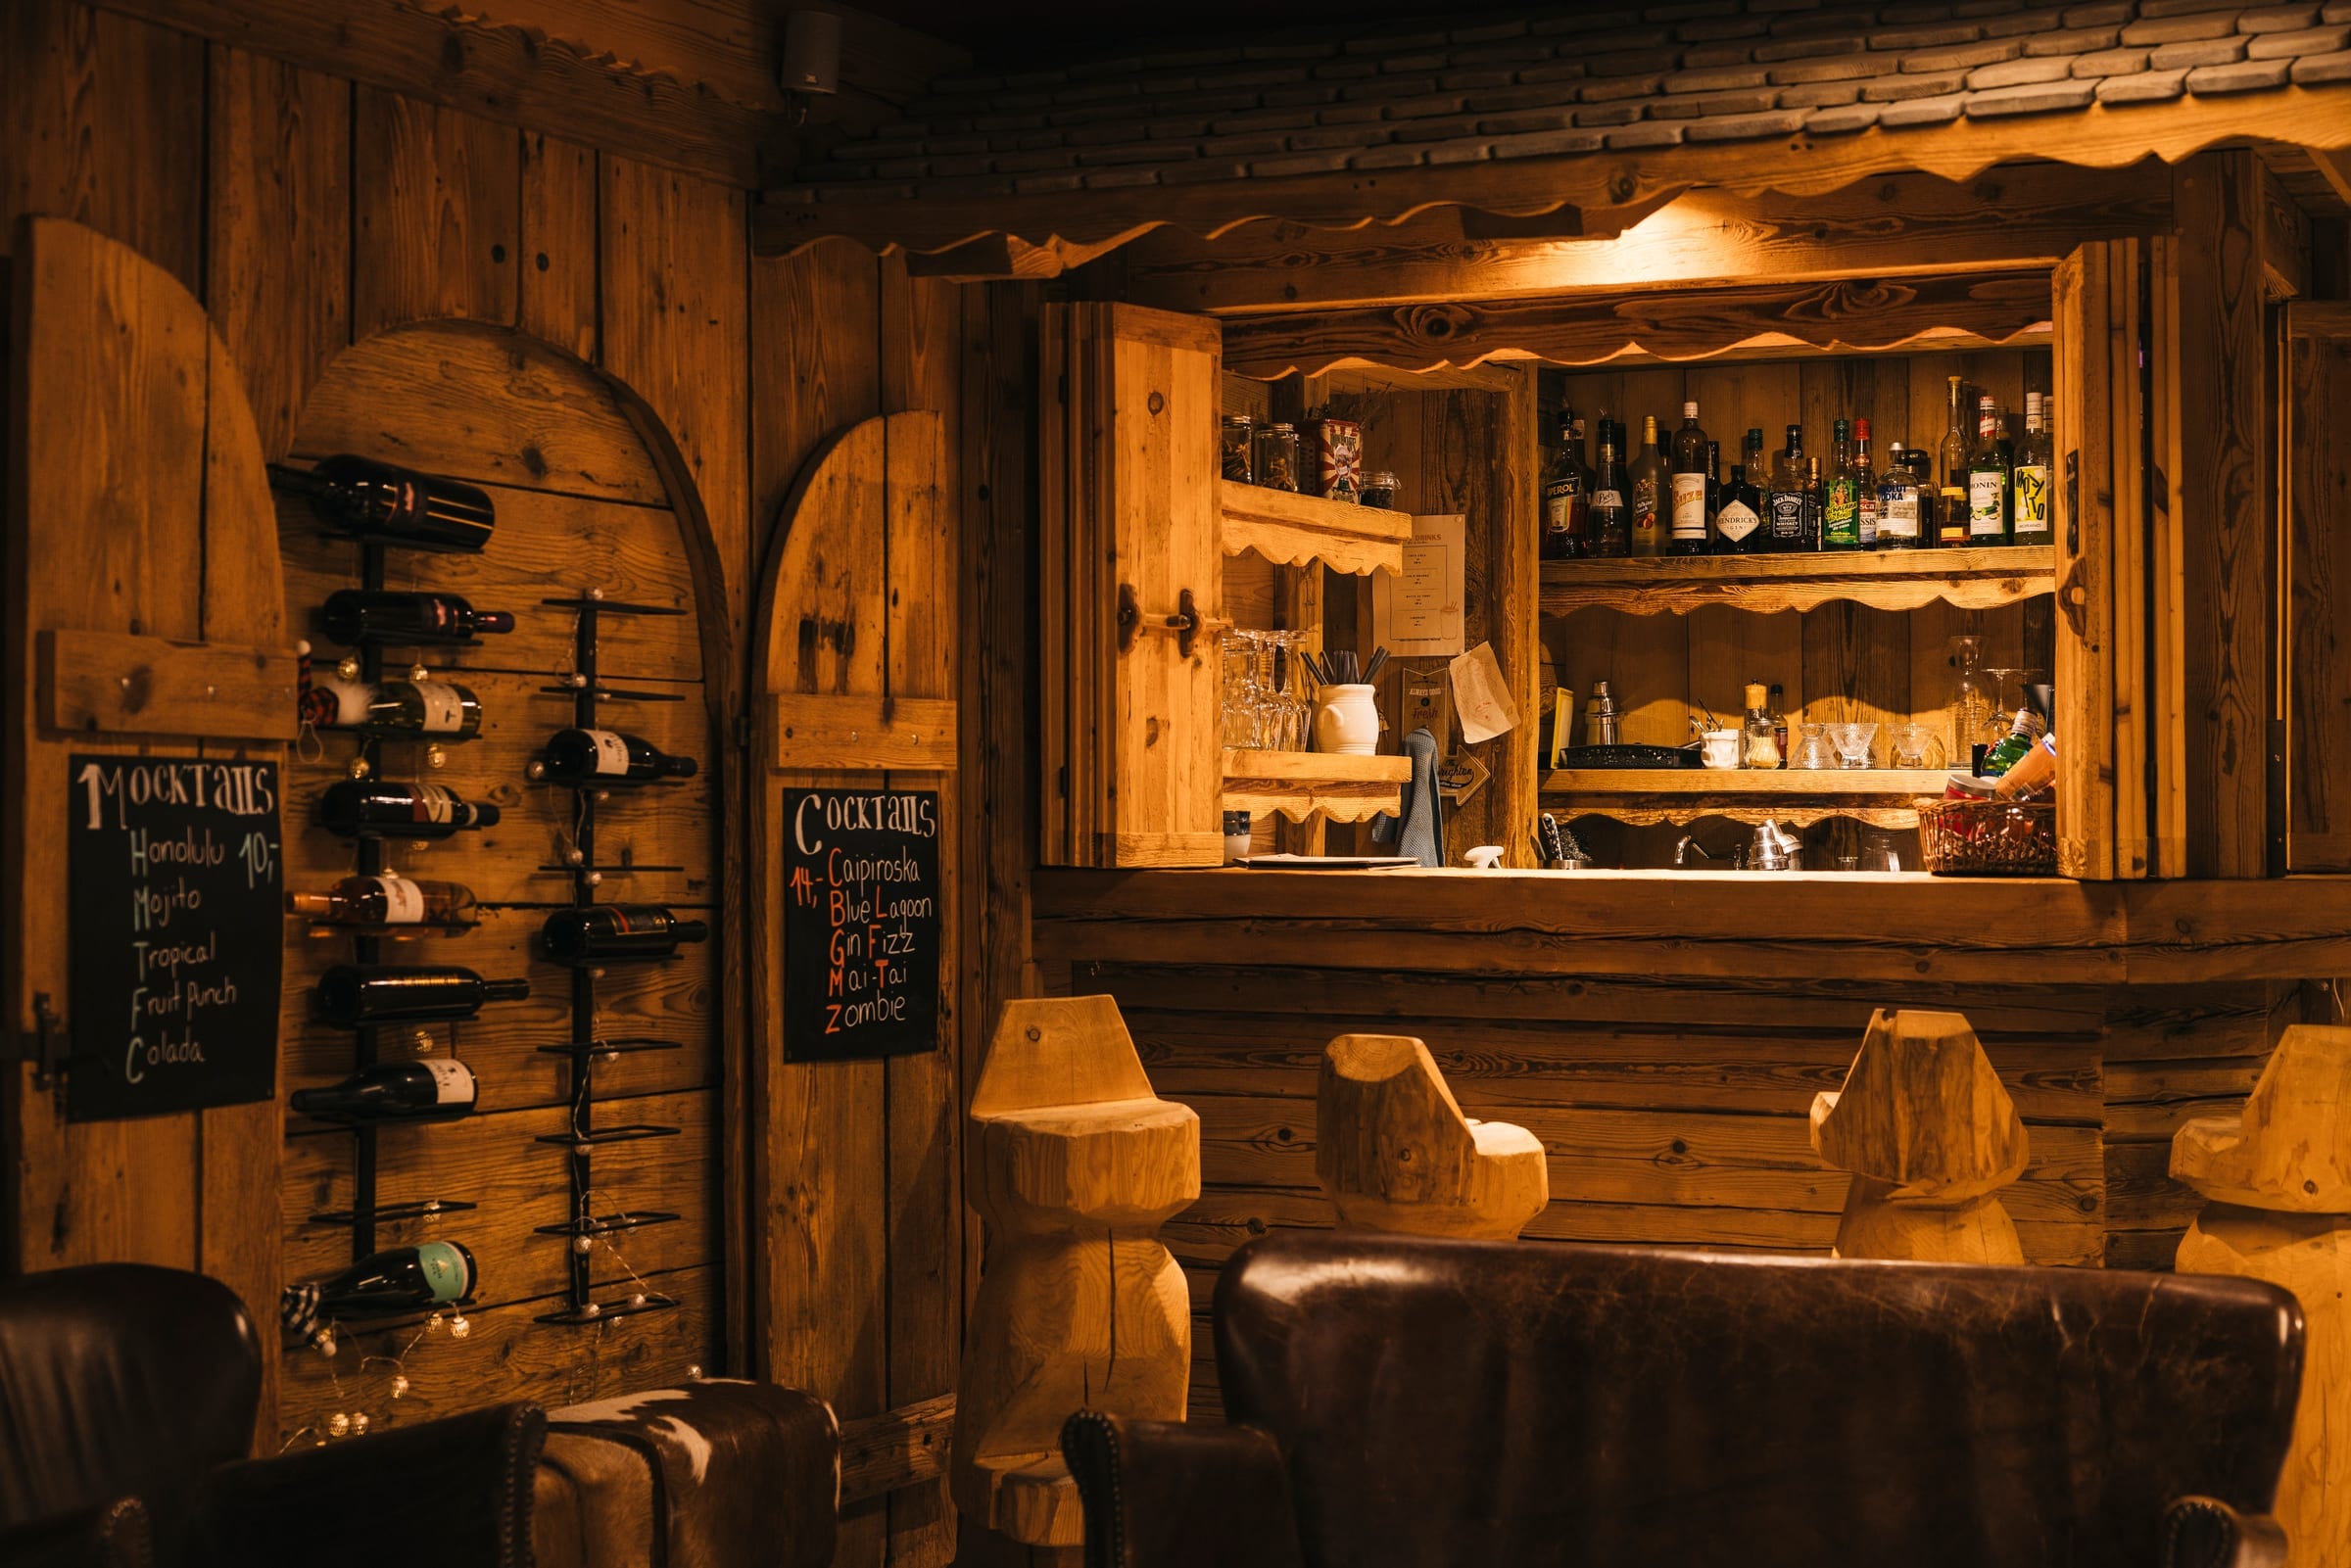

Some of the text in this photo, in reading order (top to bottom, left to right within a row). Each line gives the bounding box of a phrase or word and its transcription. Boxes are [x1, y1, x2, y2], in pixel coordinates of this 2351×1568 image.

[1773, 496, 1785, 506] JACK
[1438, 764, 1472, 781] righton
[130, 827, 225, 877] Honolulu
[828, 845, 921, 897] Caipiroska
[133, 877, 202, 931] Mojito
[830, 885, 932, 939] Blue Lagoon
[132, 931, 216, 982] Tropical
[830, 924, 916, 969] Gin Fizz
[131, 980, 181, 1031] Fruit
[825, 988, 906, 1034] Zombie
[125, 1026, 205, 1084] Colada
